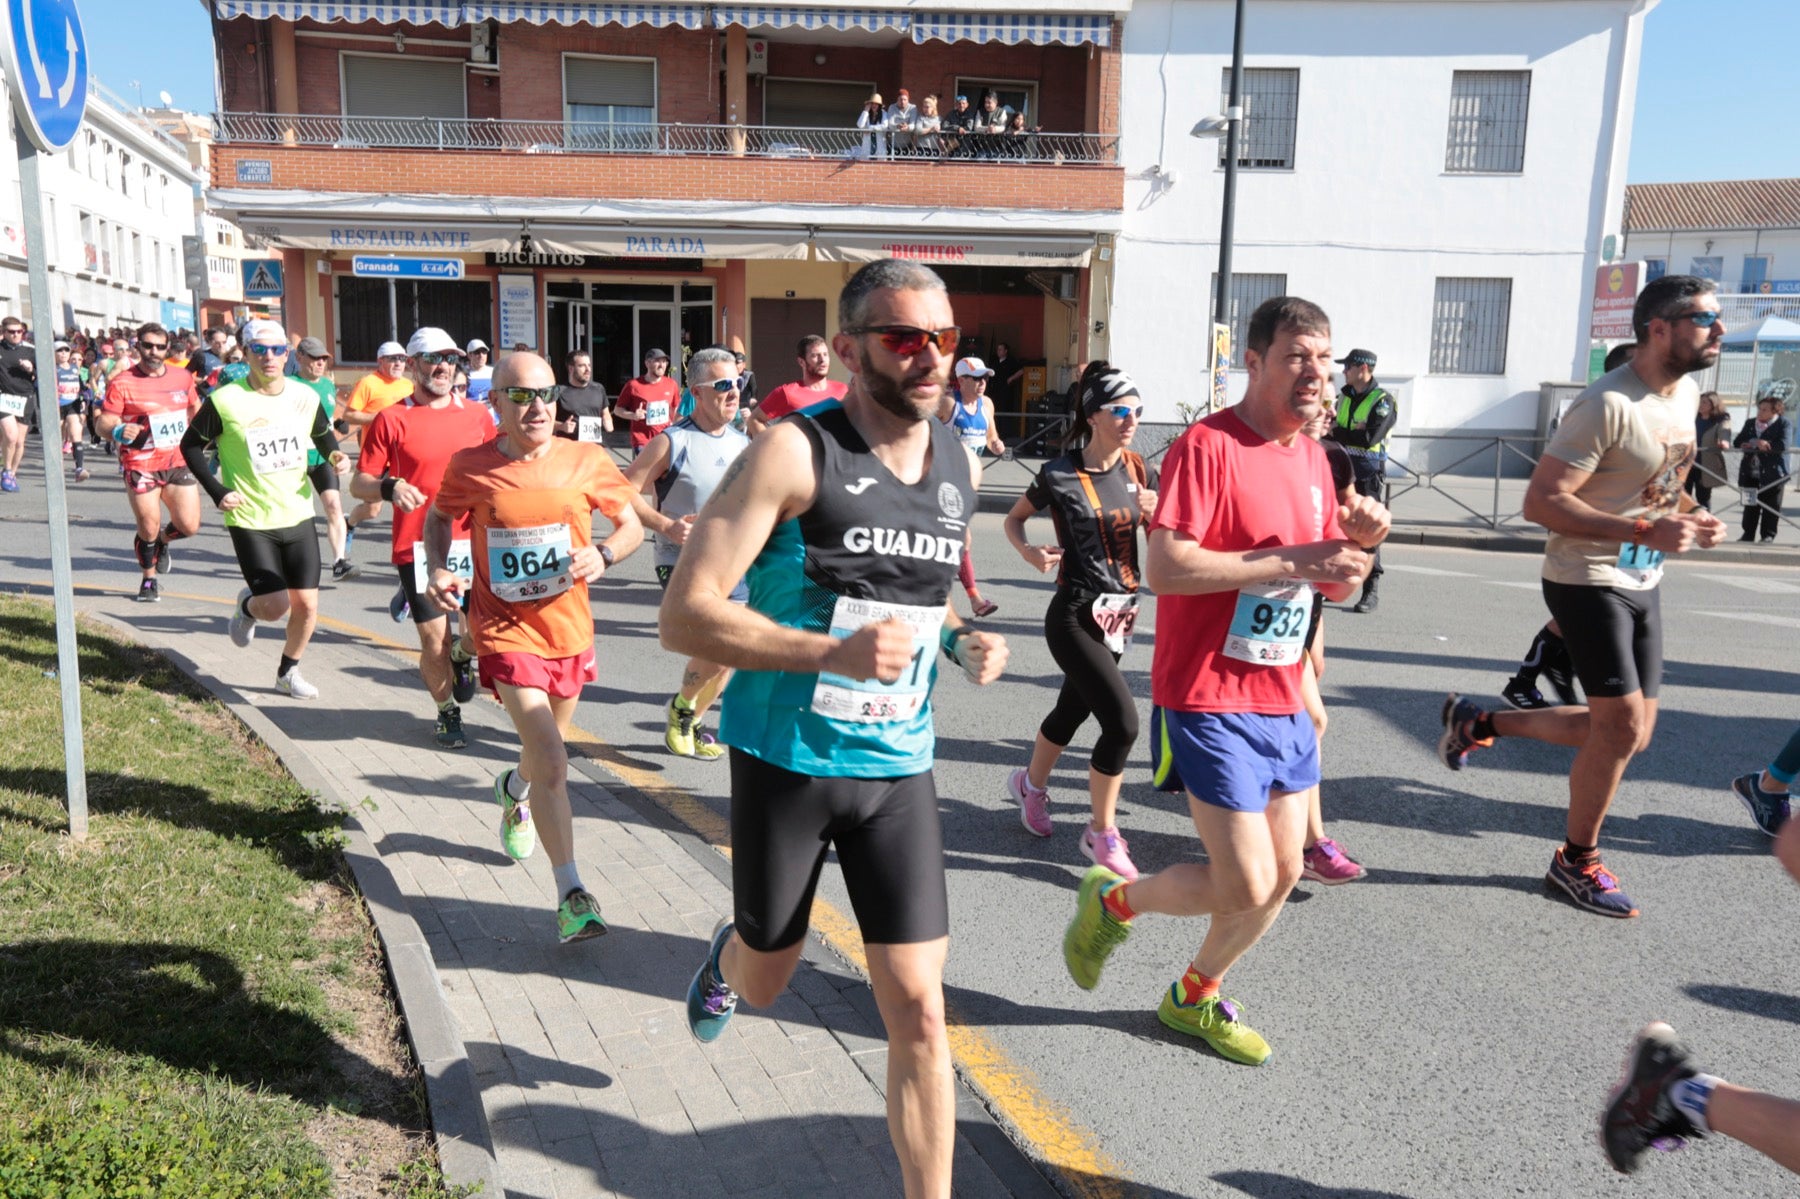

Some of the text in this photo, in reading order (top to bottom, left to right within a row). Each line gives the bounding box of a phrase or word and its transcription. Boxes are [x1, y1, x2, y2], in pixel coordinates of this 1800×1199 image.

[330, 229, 471, 247] RESTAURANTE
[627, 236, 705, 253] PARADA
[356, 262, 399, 272] Granada
[495, 251, 585, 266] BICHITOS
[1591, 327, 1631, 337] ALBOLOTE
[650, 408, 666, 418] 254
[160, 421, 184, 436] 418
[257, 436, 299, 457] 3171
[843, 527, 963, 565] GUADIX
[501, 548, 560, 578] 964
[1251, 603, 1304, 637] 932
